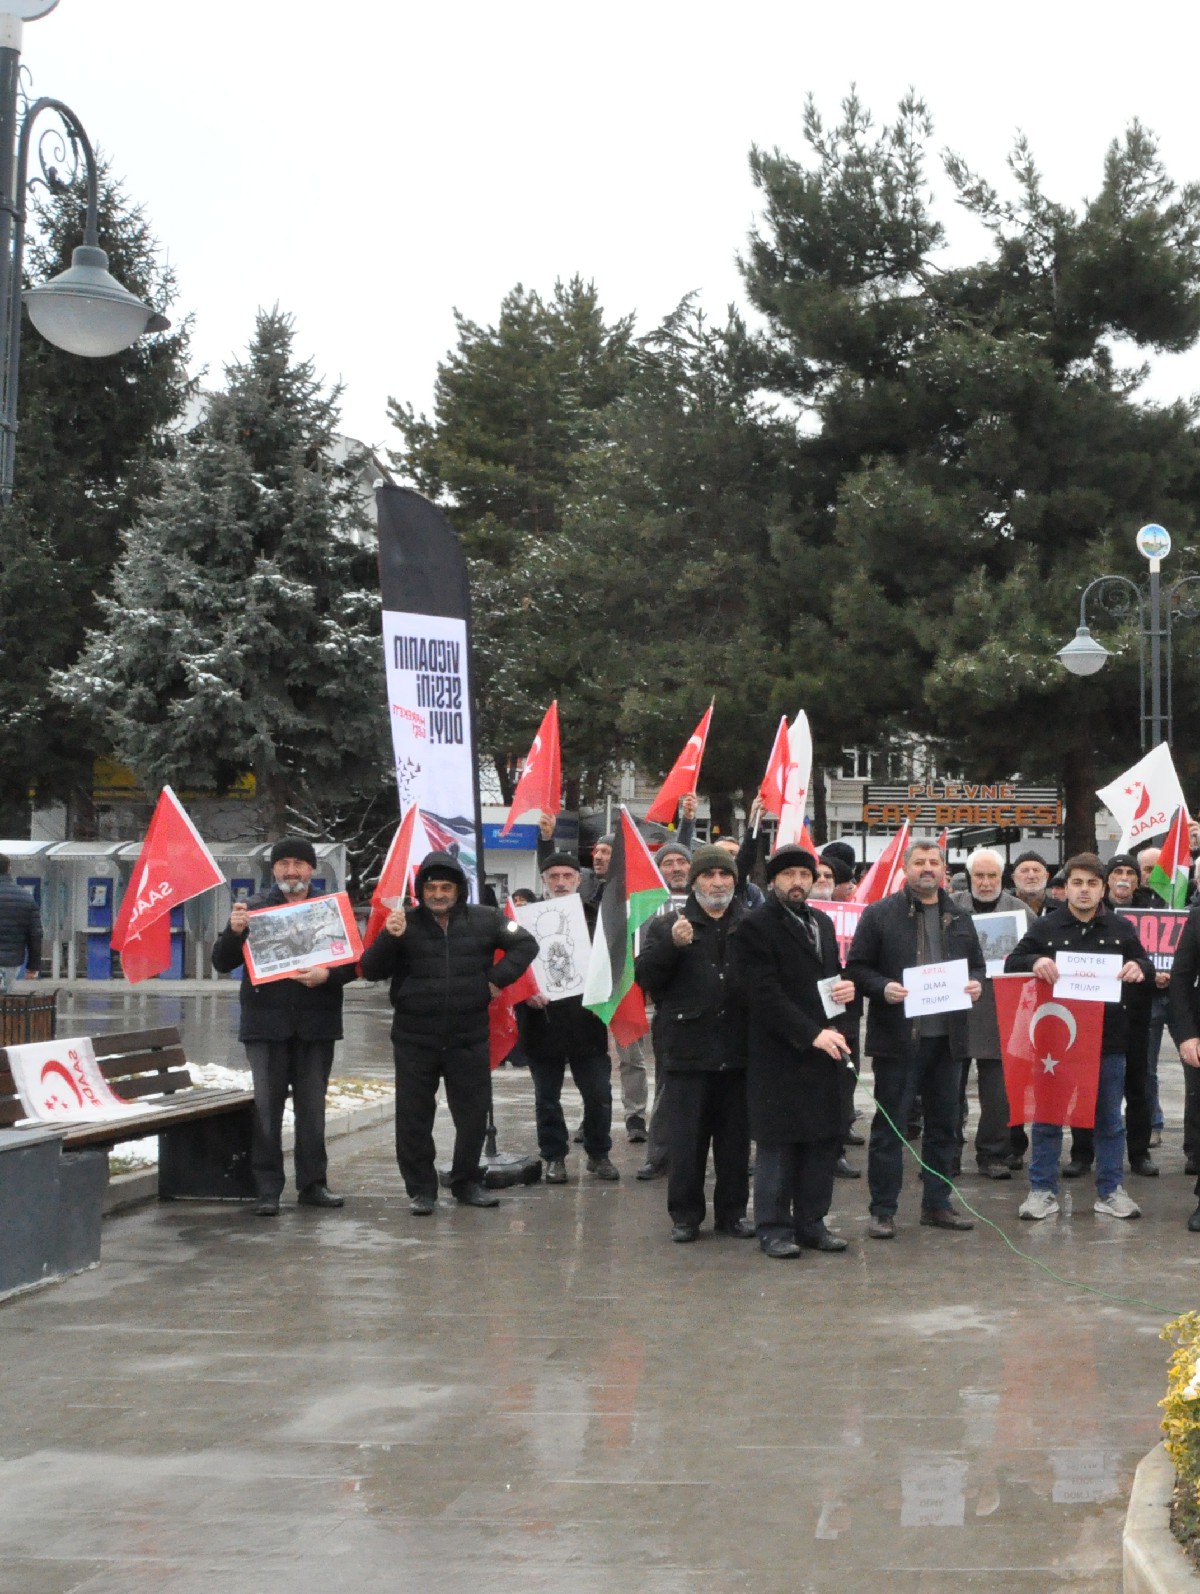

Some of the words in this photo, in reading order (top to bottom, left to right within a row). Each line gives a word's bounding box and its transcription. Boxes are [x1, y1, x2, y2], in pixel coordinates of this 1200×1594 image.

[908, 784, 1017, 799] PLEVNE
[863, 804, 922, 826] ÇAY
[923, 981, 947, 990] OLMA
[1070, 983, 1101, 991] TRUMP
[922, 995, 950, 1005] TRUMP
